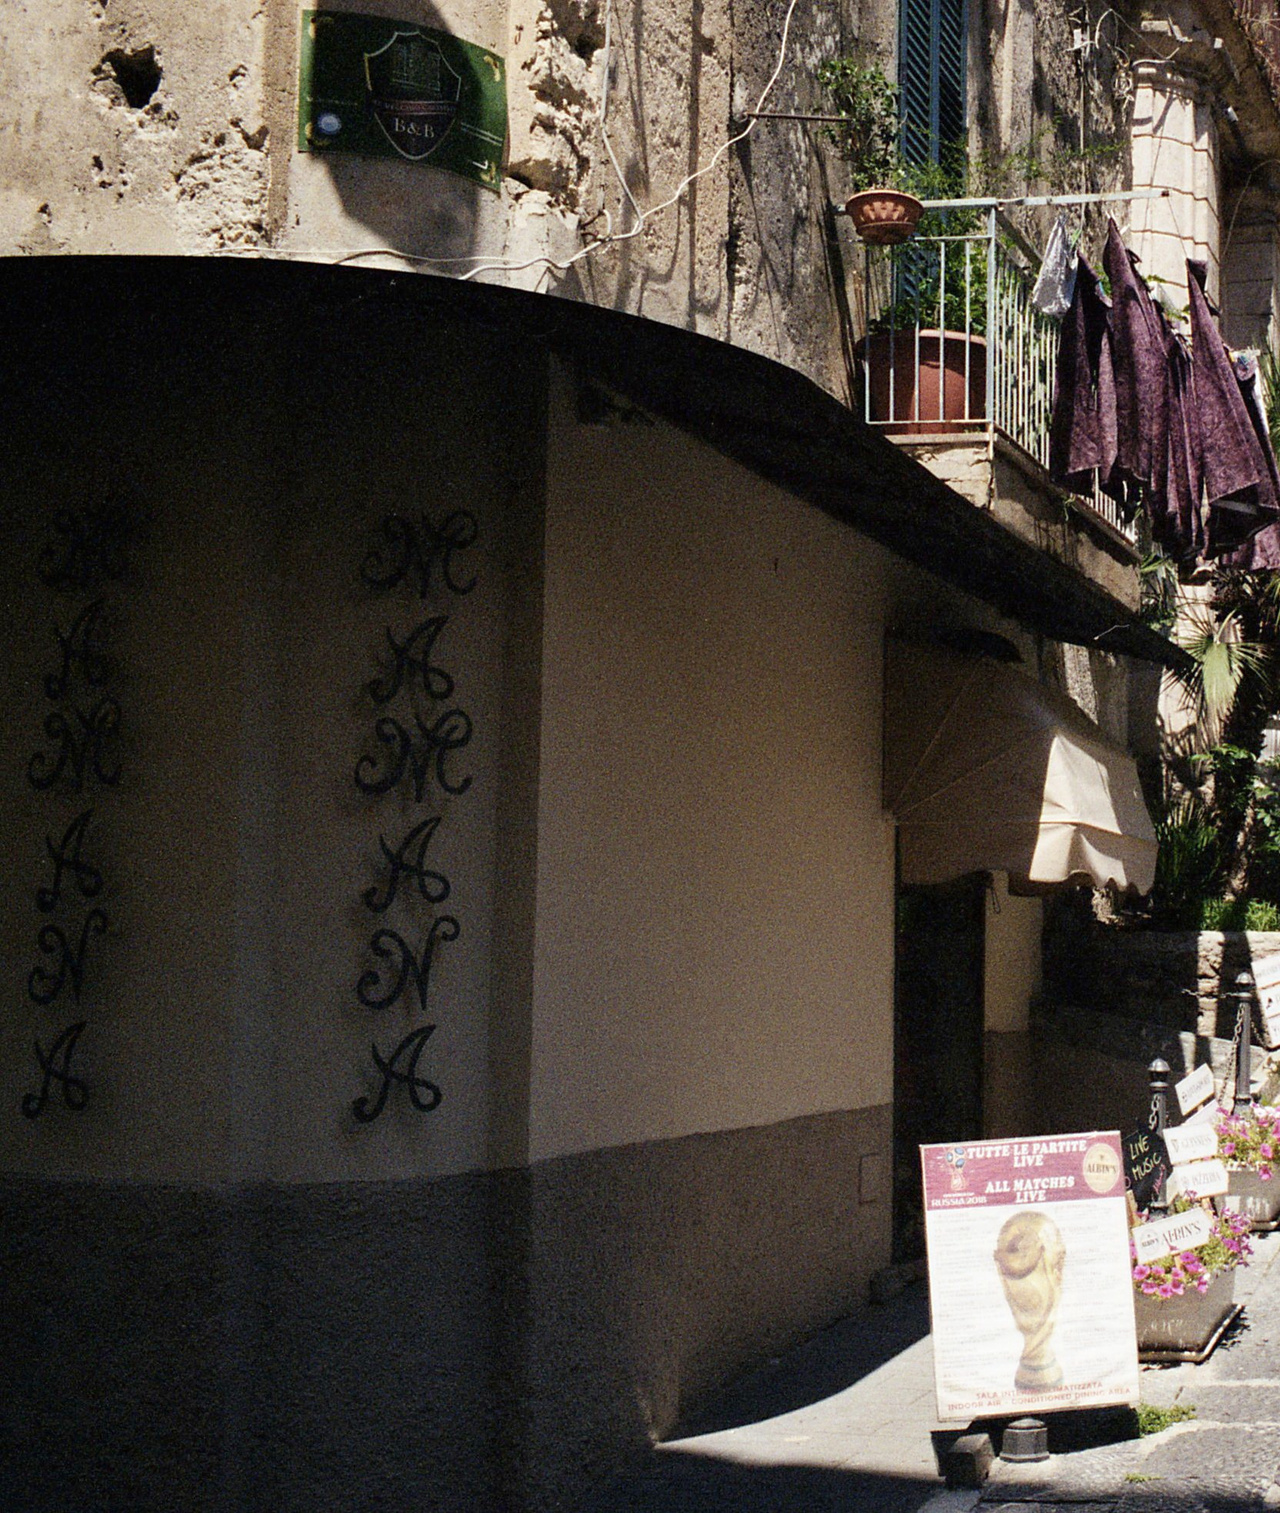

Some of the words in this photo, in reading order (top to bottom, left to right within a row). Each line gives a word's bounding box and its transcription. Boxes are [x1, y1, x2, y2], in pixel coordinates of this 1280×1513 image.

[967, 1143, 1010, 1159] TUTTE
[1013, 1142, 1030, 1155] LE
[1032, 1140, 1087, 1154] PARTITE
[1129, 1134, 1150, 1160] LIVE
[1013, 1154, 1044, 1168] LIVE
[1087, 1163, 1117, 1174] ALBIN'S
[1131, 1152, 1162, 1181] MUSIC
[985, 1180, 1011, 1194] ALL
[1013, 1176, 1075, 1193] MATCHES
[931, 1197, 965, 1207] RUSSIA
[966, 1195, 987, 1204] 2018
[1016, 1190, 1046, 1204] LIVE
[1162, 1221, 1202, 1245] ALBIN'S
[976, 1391, 998, 1400] SALA
